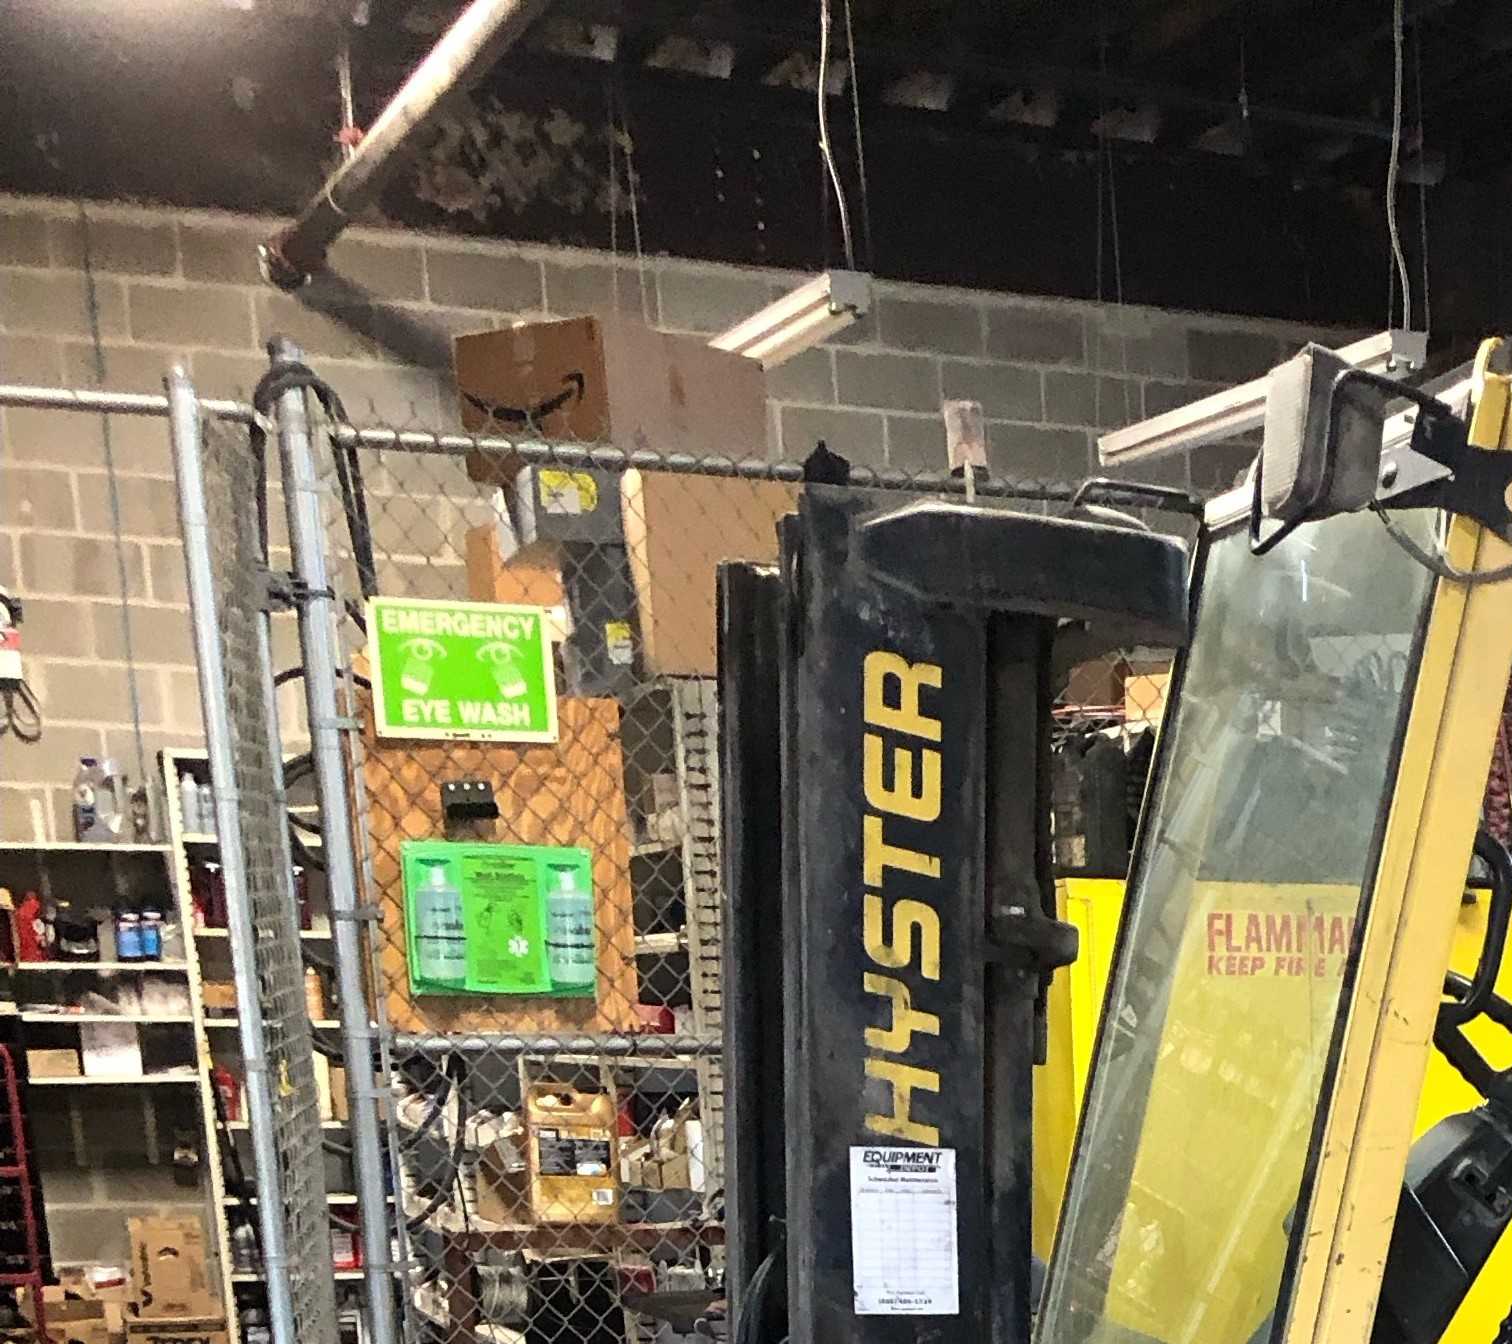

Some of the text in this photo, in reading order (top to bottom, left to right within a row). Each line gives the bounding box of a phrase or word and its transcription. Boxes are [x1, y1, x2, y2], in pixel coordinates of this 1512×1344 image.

[382, 608, 534, 639] EMERGENCY
[403, 699, 530, 726] EYE WASH
[864, 650, 942, 1147] HYSTER
[1207, 912, 1356, 954] FLAMMA
[1208, 955, 1265, 976] KEEP
[1274, 956, 1326, 977] FIRE
[863, 1150, 942, 1164] EQUIPMENT
